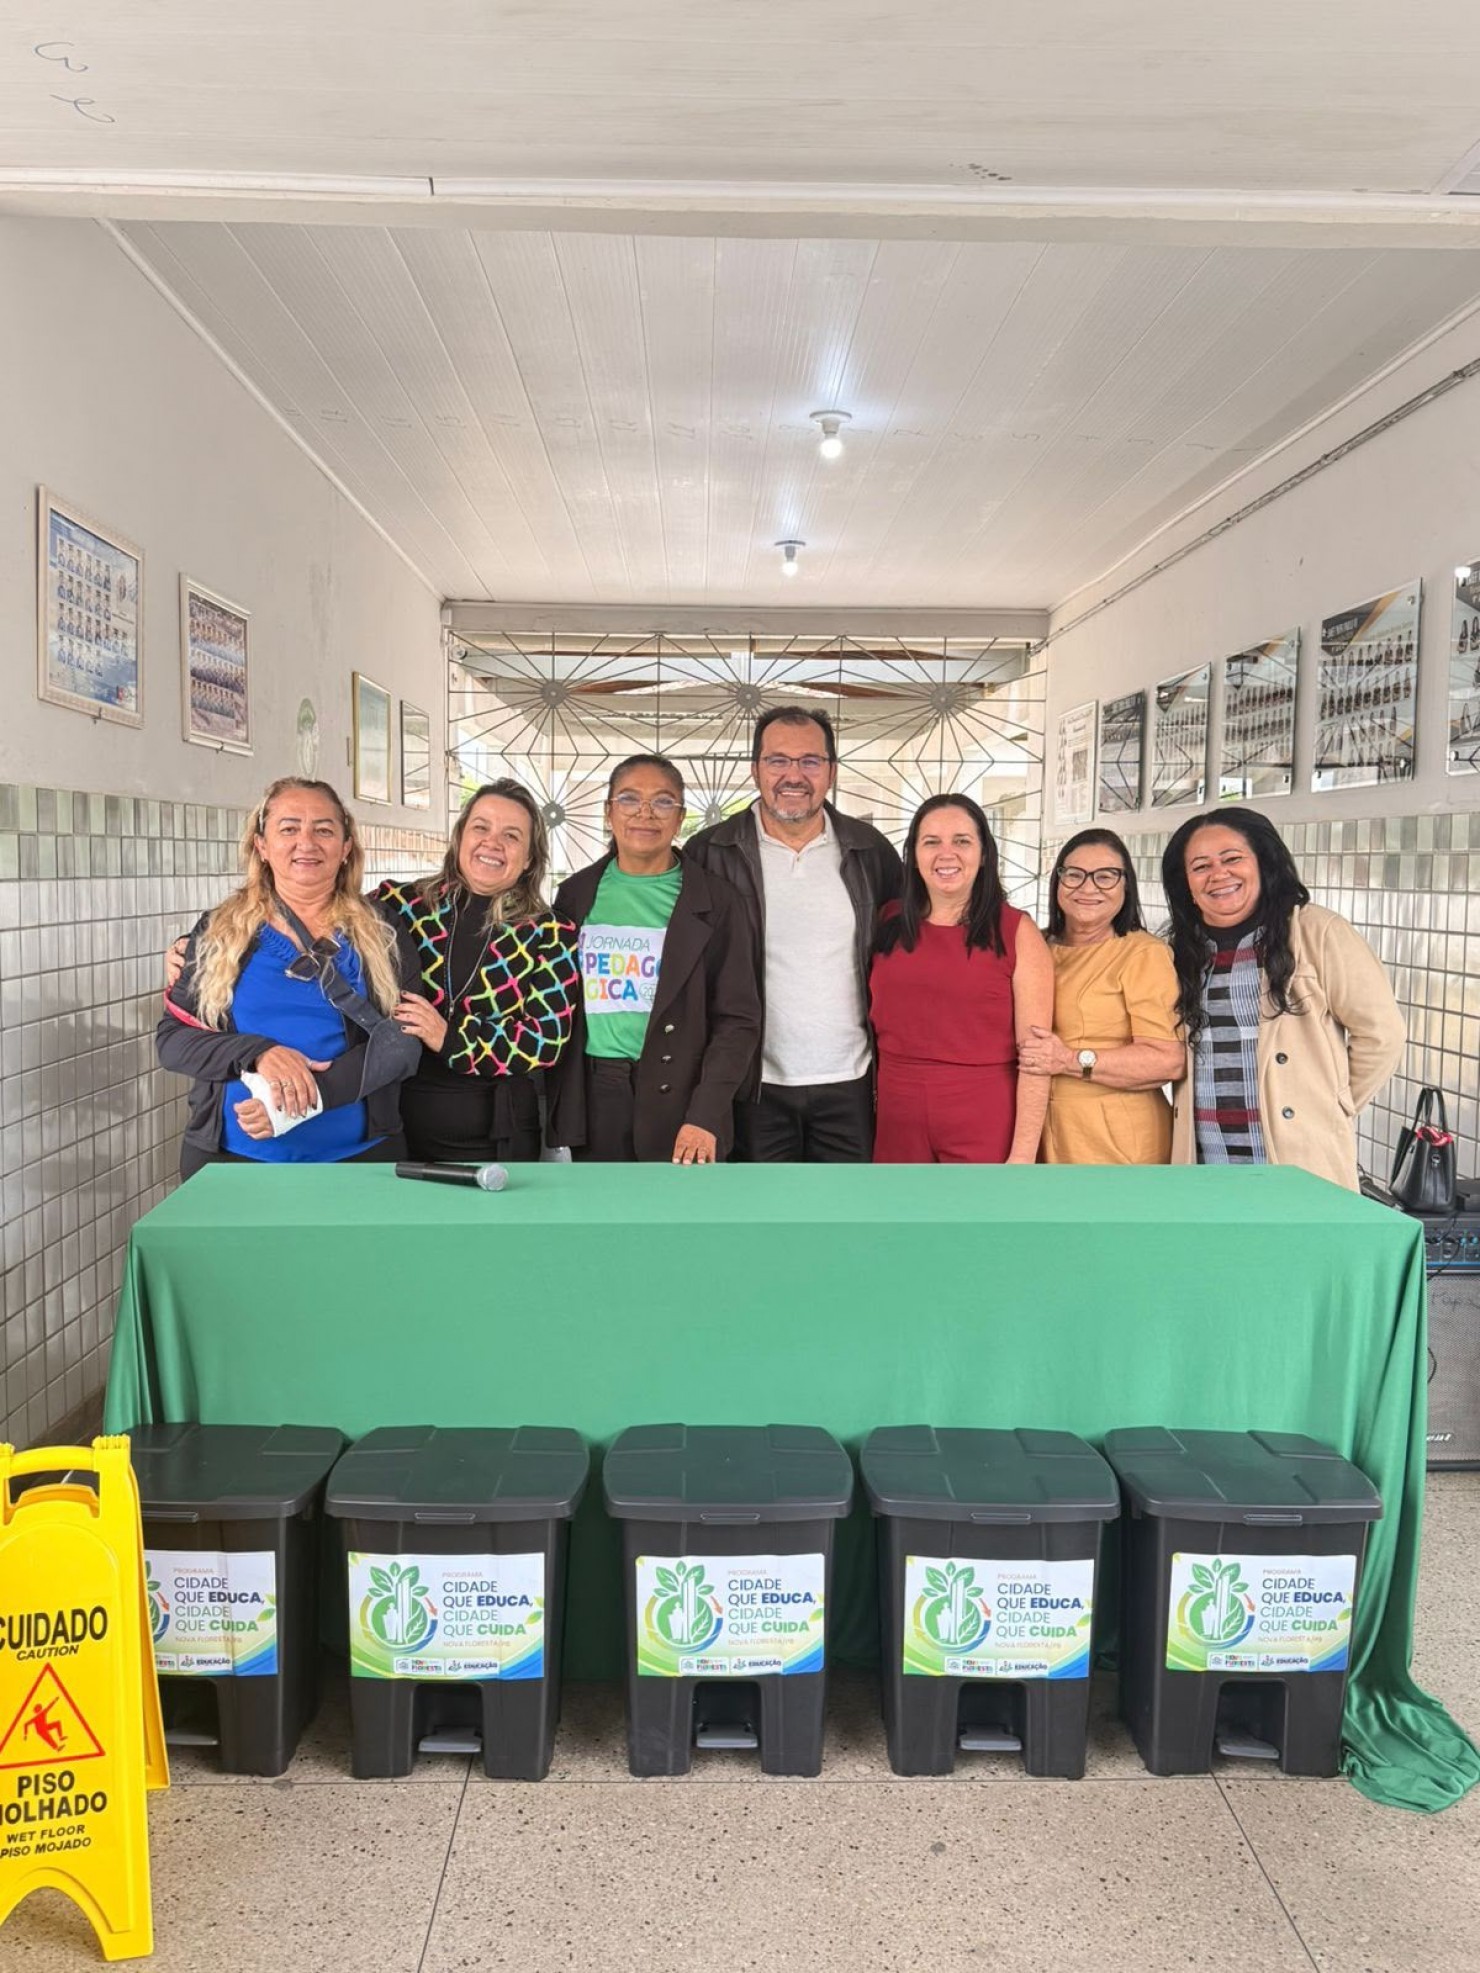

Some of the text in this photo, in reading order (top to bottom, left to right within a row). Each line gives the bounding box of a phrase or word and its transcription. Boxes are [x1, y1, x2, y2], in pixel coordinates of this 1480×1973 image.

[586, 935, 650, 951] JORNADA
[585, 978, 638, 1001] GICA
[174, 1577, 228, 1589] CIDADE
[442, 1581, 498, 1593] CIDADE
[728, 1579, 782, 1591] CIDADE
[997, 1583, 1051, 1595] CIDADE
[1262, 1577, 1315, 1590] CIDADE
[174, 1591, 265, 1604] QUE EDUCA,
[443, 1595, 533, 1609] QUE EDUCA,
[728, 1592, 816, 1606] QUE EDUCA,
[997, 1597, 1084, 1610] QUE EDUCA,
[1261, 1591, 1345, 1604] QUE EDUCA,
[175, 1606, 230, 1618] CIDADE
[443, 1610, 498, 1622] CIDADE
[728, 1607, 782, 1620] CIDADE
[996, 1611, 1050, 1624] CIDADE
[1260, 1606, 1312, 1618] CIDADE
[175, 1620, 259, 1632] QUE CUIDA
[443, 1623, 526, 1637] QUE CUIDA
[728, 1621, 810, 1635] QUE CUIDA
[996, 1625, 1077, 1639] QUE CUIDA
[1259, 1619, 1338, 1633] QUE CUIDA
[16, 1644, 80, 1661] CAUTION
[464, 1661, 498, 1669] EDUCAÇÃO
[748, 1659, 781, 1667] EDUCAÇÃO
[1276, 1657, 1309, 1665] EDUCAÇÃO
[17, 1770, 75, 1798] PISO
[0, 1791, 108, 1826] OLHADO
[7, 1824, 86, 1844] WET FLOOR
[0, 1837, 92, 1859] PISO MOJADO
